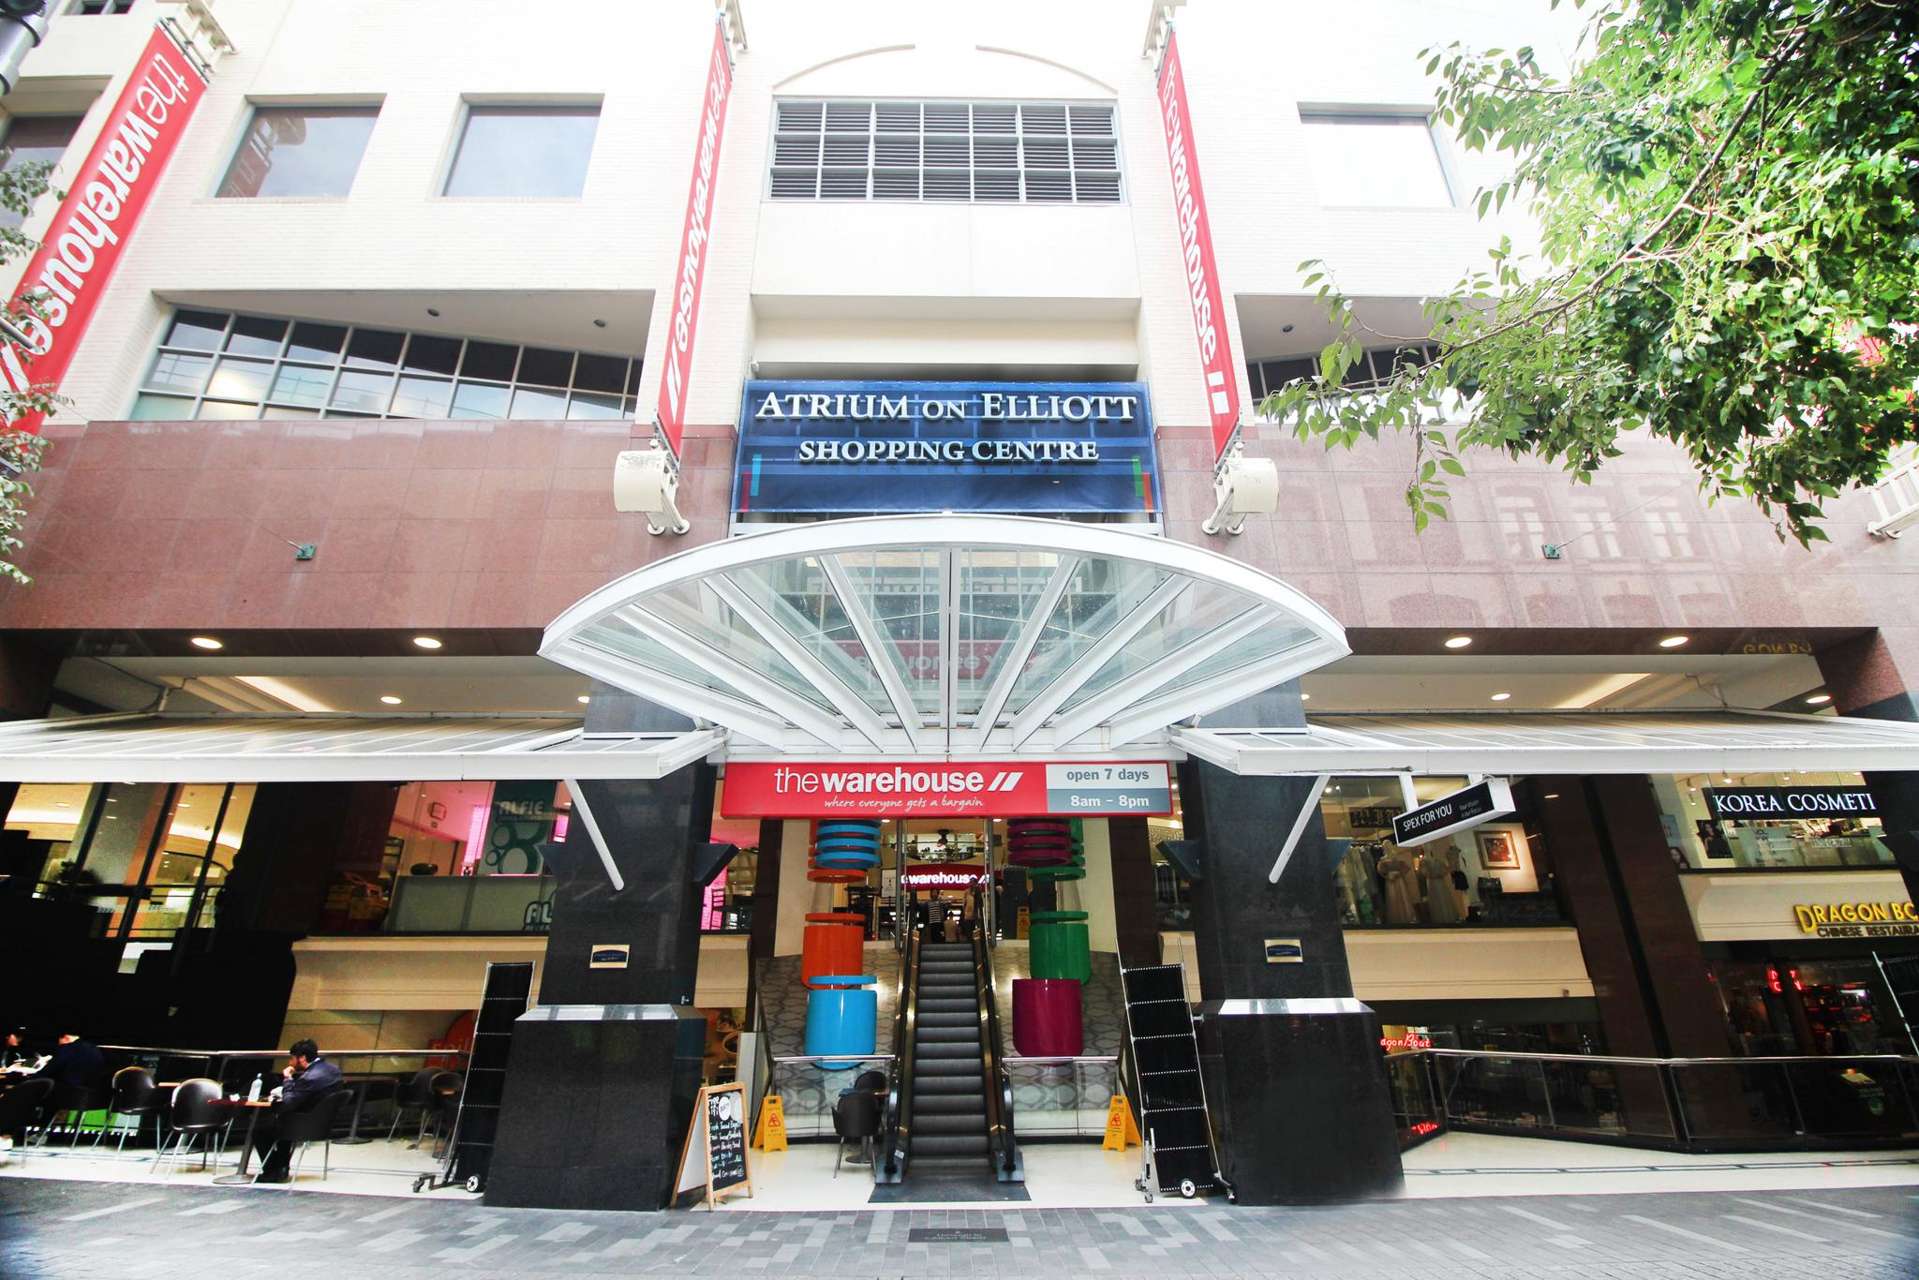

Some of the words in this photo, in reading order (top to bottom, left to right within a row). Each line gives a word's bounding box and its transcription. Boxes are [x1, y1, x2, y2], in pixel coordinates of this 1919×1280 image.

[135, 53, 190, 125] the
[14, 110, 160, 356] warehouse
[675, 106, 718, 353] warehouse
[1170, 116, 1216, 365] warehouse
[755, 391, 912, 419] ATRIUM
[922, 399, 967, 420] ON
[981, 392, 1137, 421] ELLIOTT
[799, 440, 964, 462] SHOPPING
[971, 440, 1099, 462] CENTRE
[774, 767, 819, 793] the
[820, 766, 984, 793] warehouse
[1066, 770, 1100, 783] open
[1104, 768, 1113, 780] 7
[1118, 768, 1150, 782] days
[824, 795, 855, 808] where
[858, 800, 903, 813] everyone
[905, 797, 927, 813] gets
[930, 799, 939, 807] a
[941, 795, 984, 812] bargain
[1070, 794, 1101, 807] 8am
[1118, 794, 1150, 809] 8pm
[1713, 793, 1784, 812] KOREA
[1787, 793, 1877, 811] COSMETI
[1403, 816, 1421, 832] SPEX
[1420, 810, 1436, 825] FOR
[1435, 802, 1453, 819] YOU
[1794, 902, 1888, 933] DRAGON
[1816, 926, 1863, 937] CHINESE
